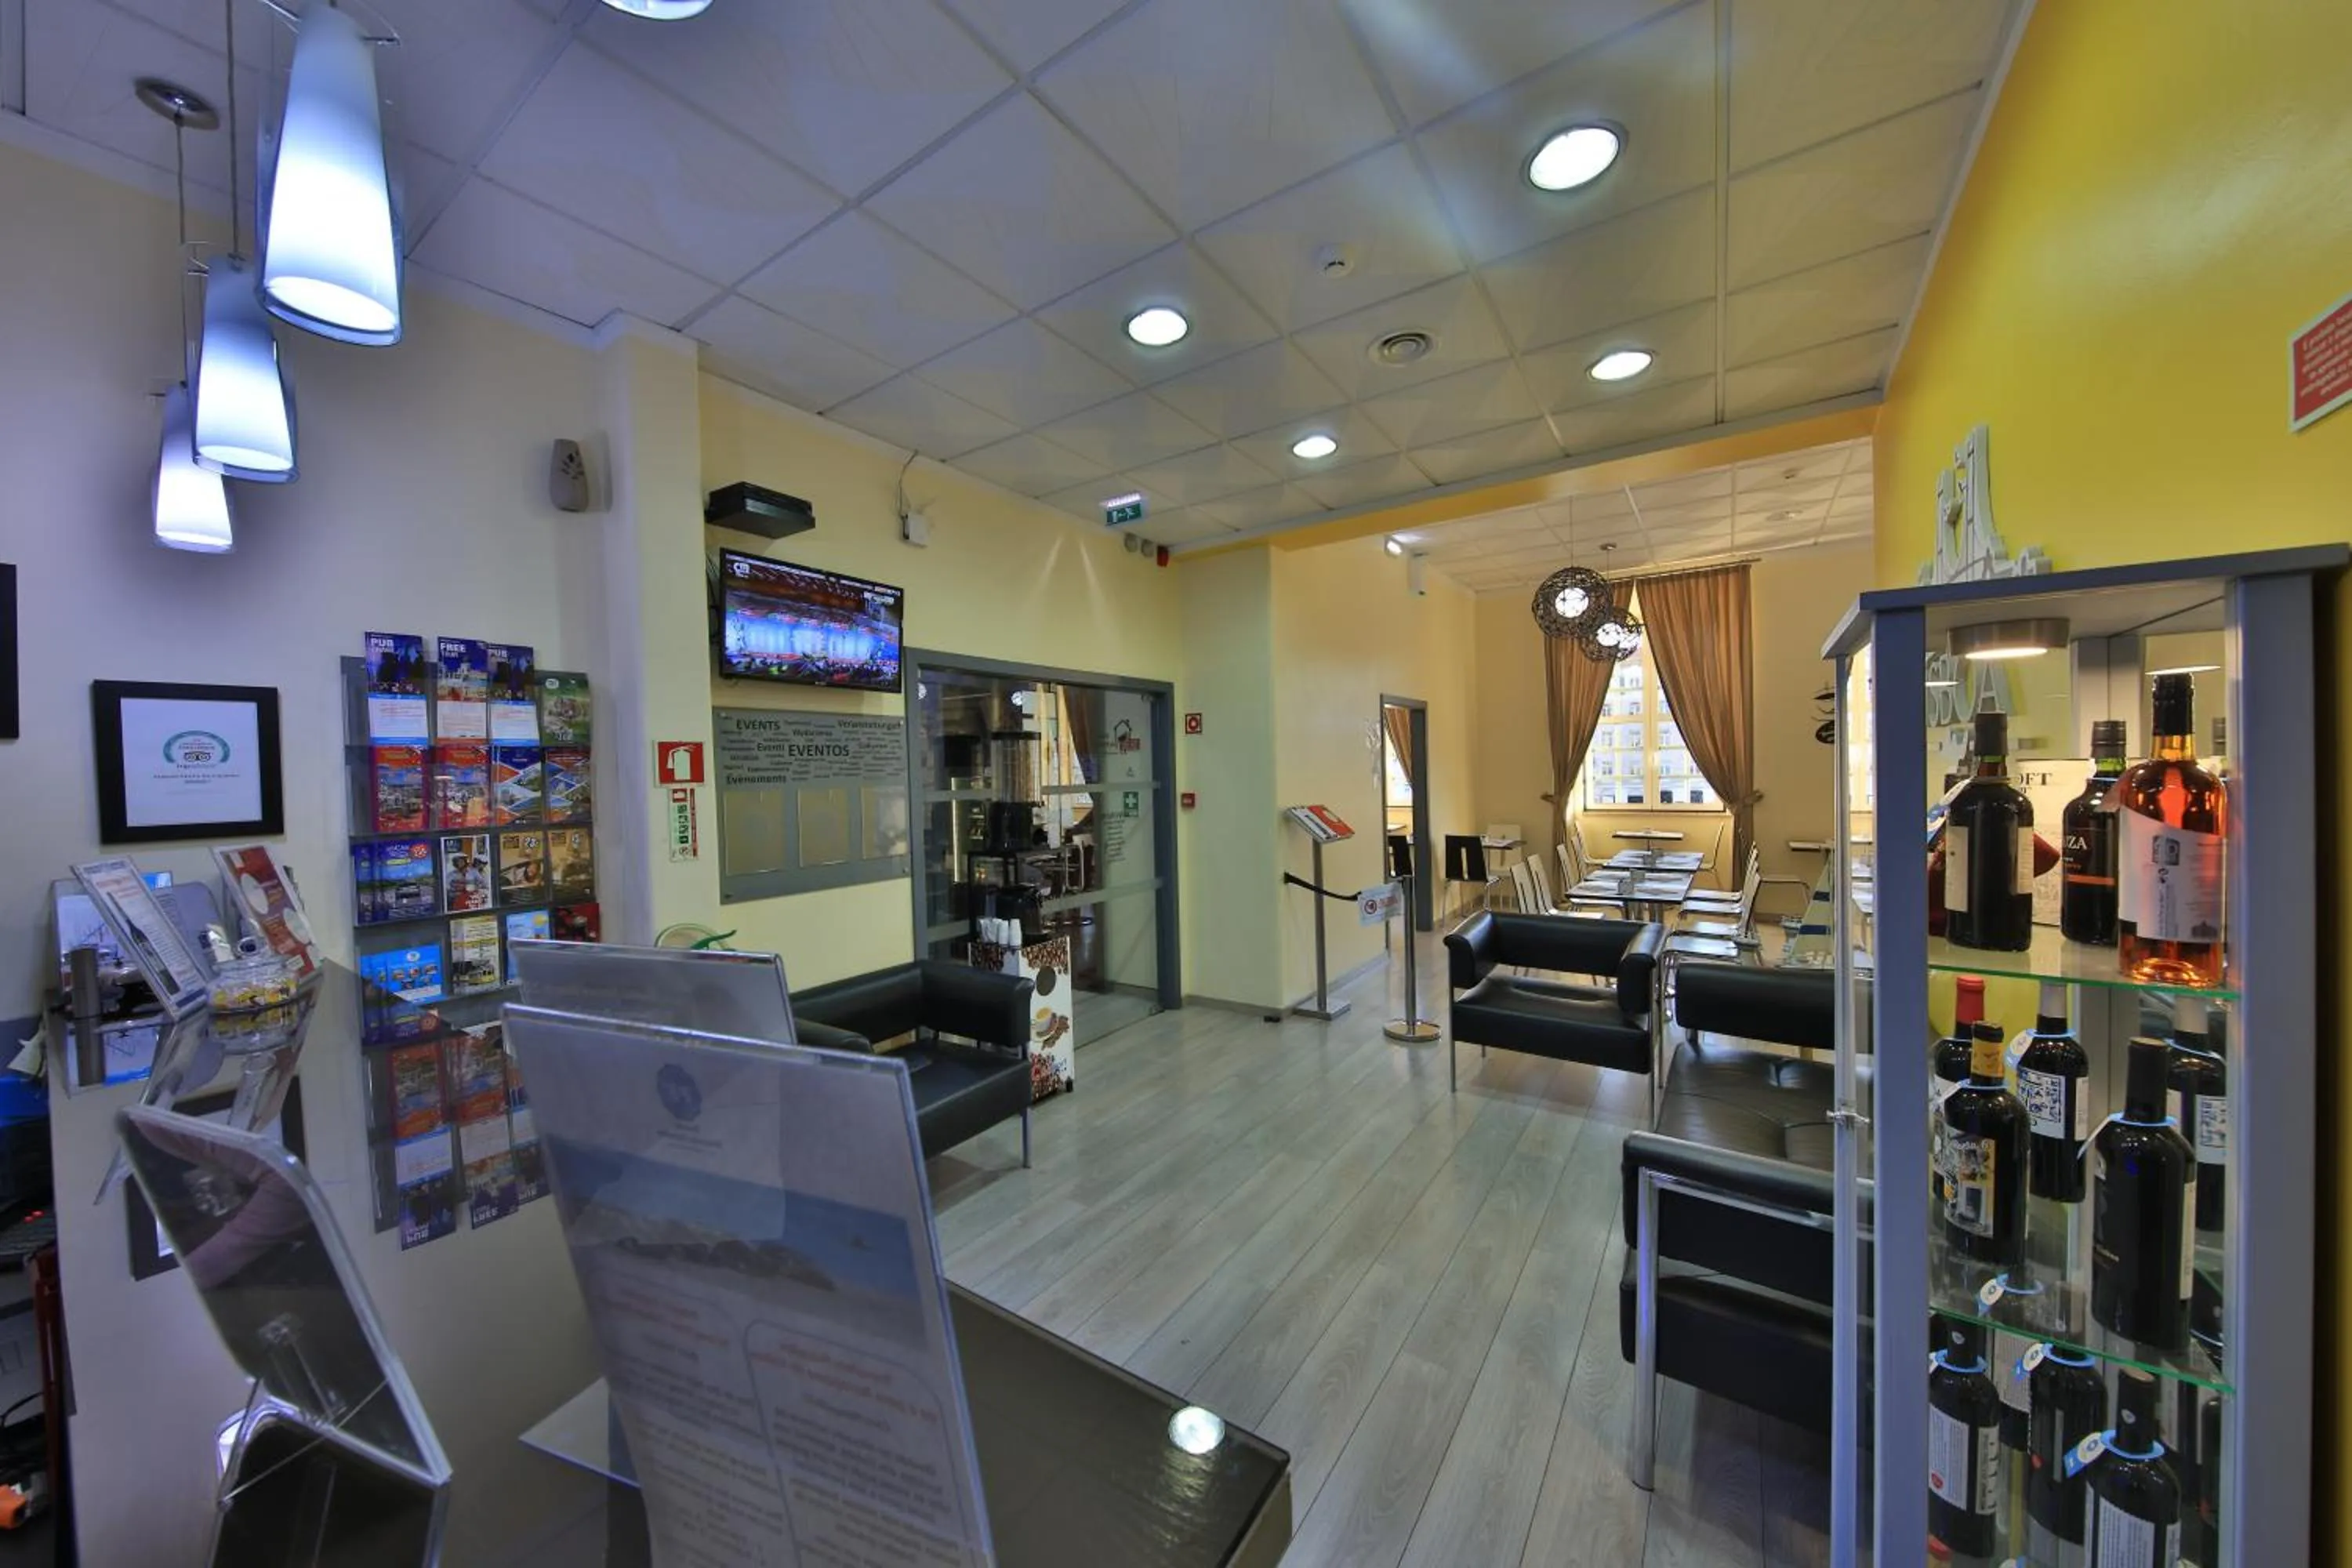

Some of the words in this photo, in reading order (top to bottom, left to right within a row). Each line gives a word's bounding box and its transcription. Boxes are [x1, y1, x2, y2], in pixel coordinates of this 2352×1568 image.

[371, 638, 394, 648] PUB
[440, 642, 466, 652] FREE
[736, 719, 781, 731] EVENTS
[757, 743, 785, 752] Eventi
[787, 745, 849, 757] EVENTOS
